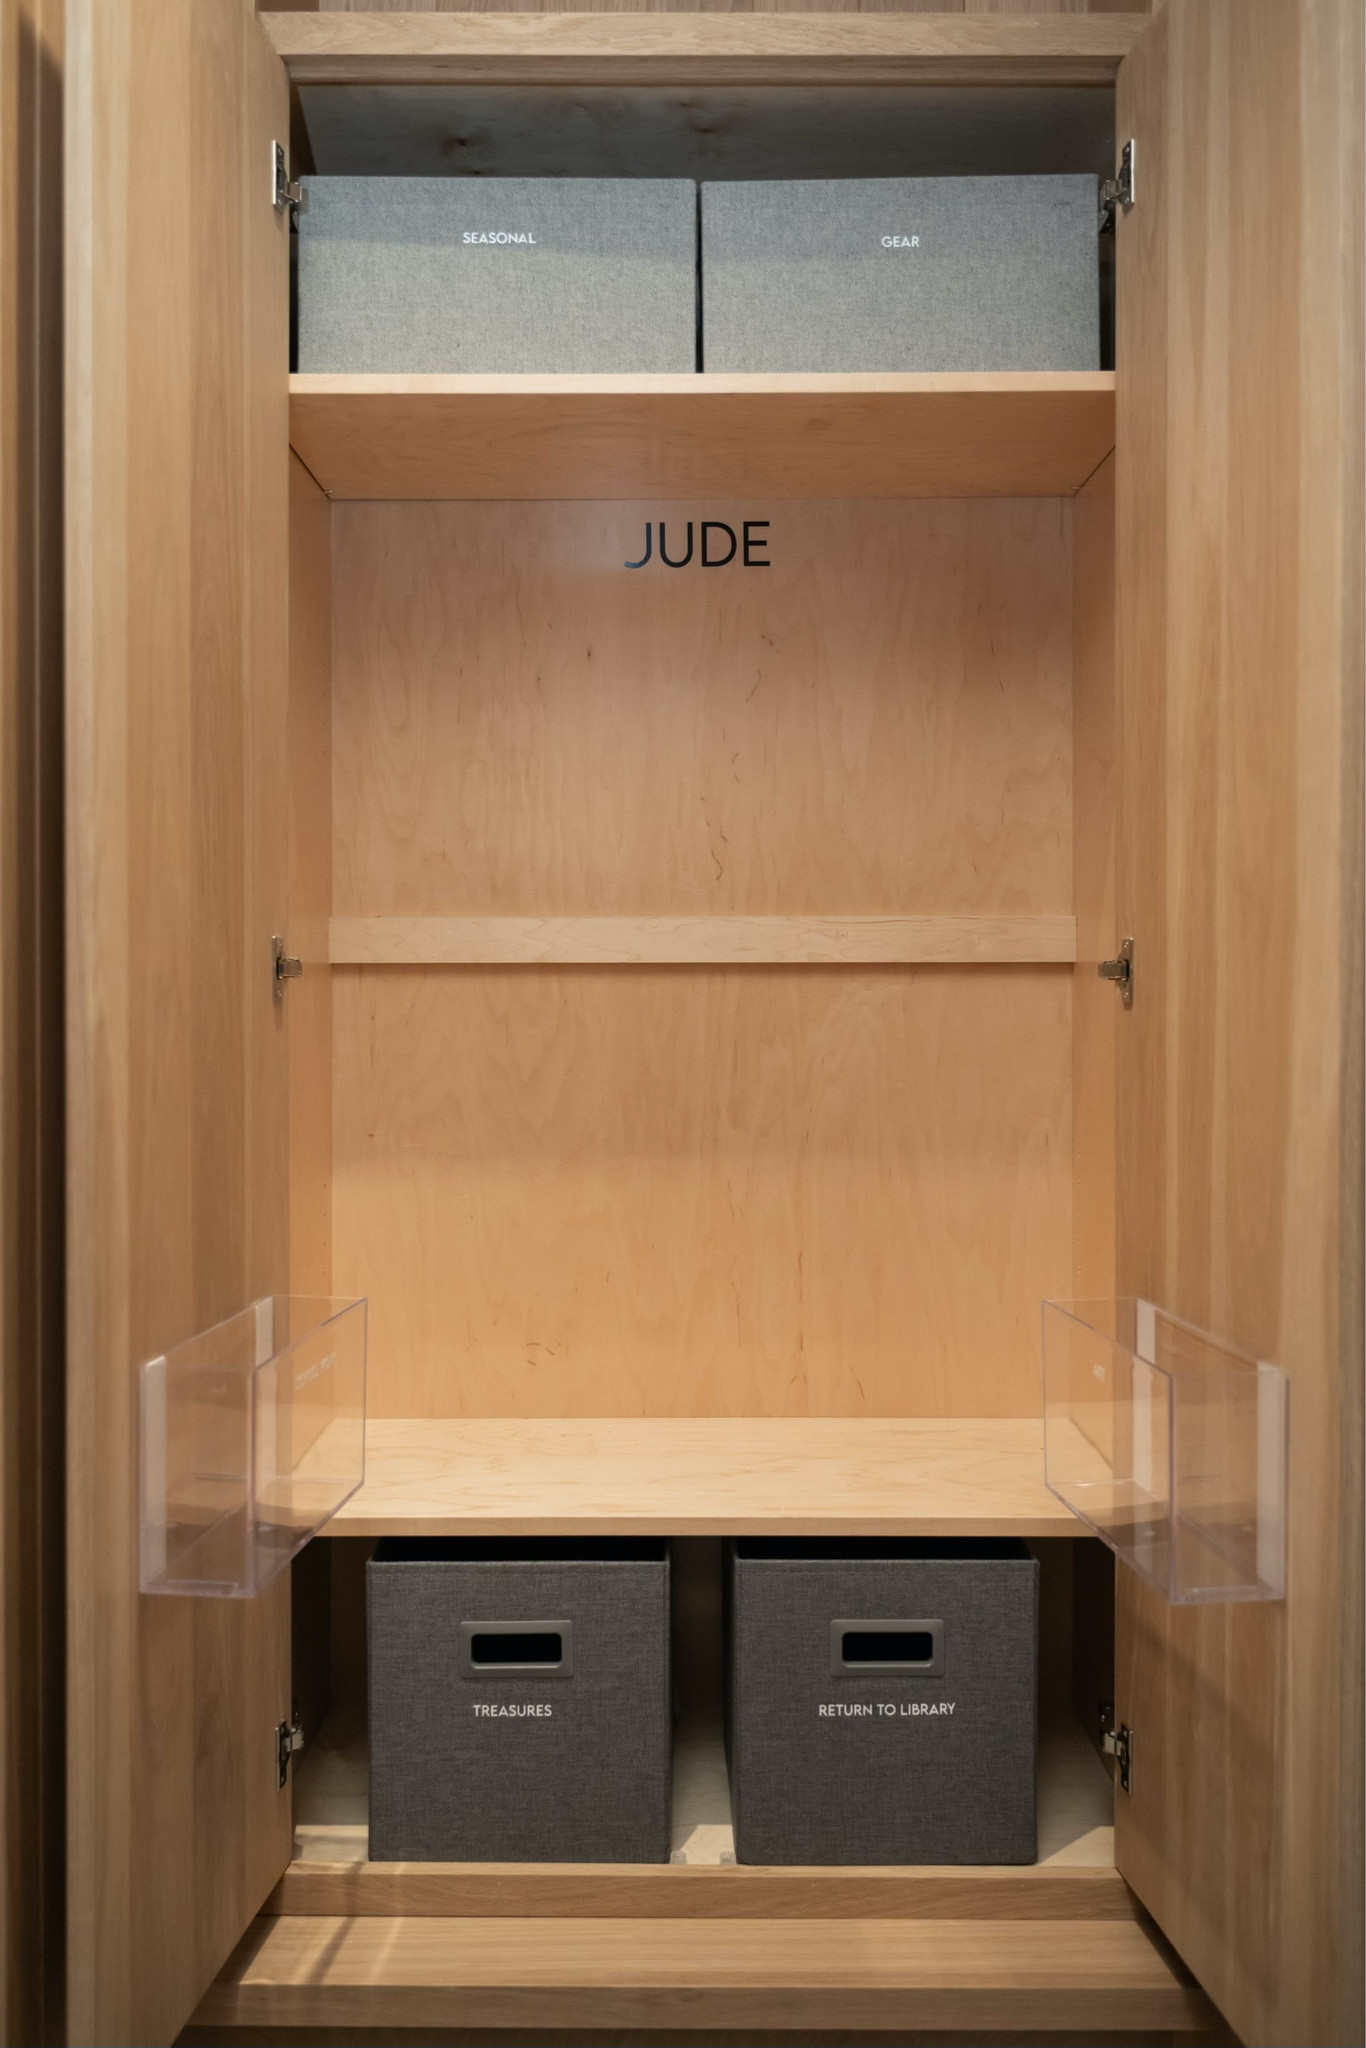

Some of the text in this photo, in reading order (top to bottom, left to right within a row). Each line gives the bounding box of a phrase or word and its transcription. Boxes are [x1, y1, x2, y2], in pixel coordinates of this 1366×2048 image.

[462, 232, 537, 244] SEASONAL
[881, 235, 920, 248] GEAR
[624, 521, 771, 568] JUDE
[472, 1704, 552, 1717] TREASURES
[818, 1702, 956, 1716] RETURN TO LIBRARY
